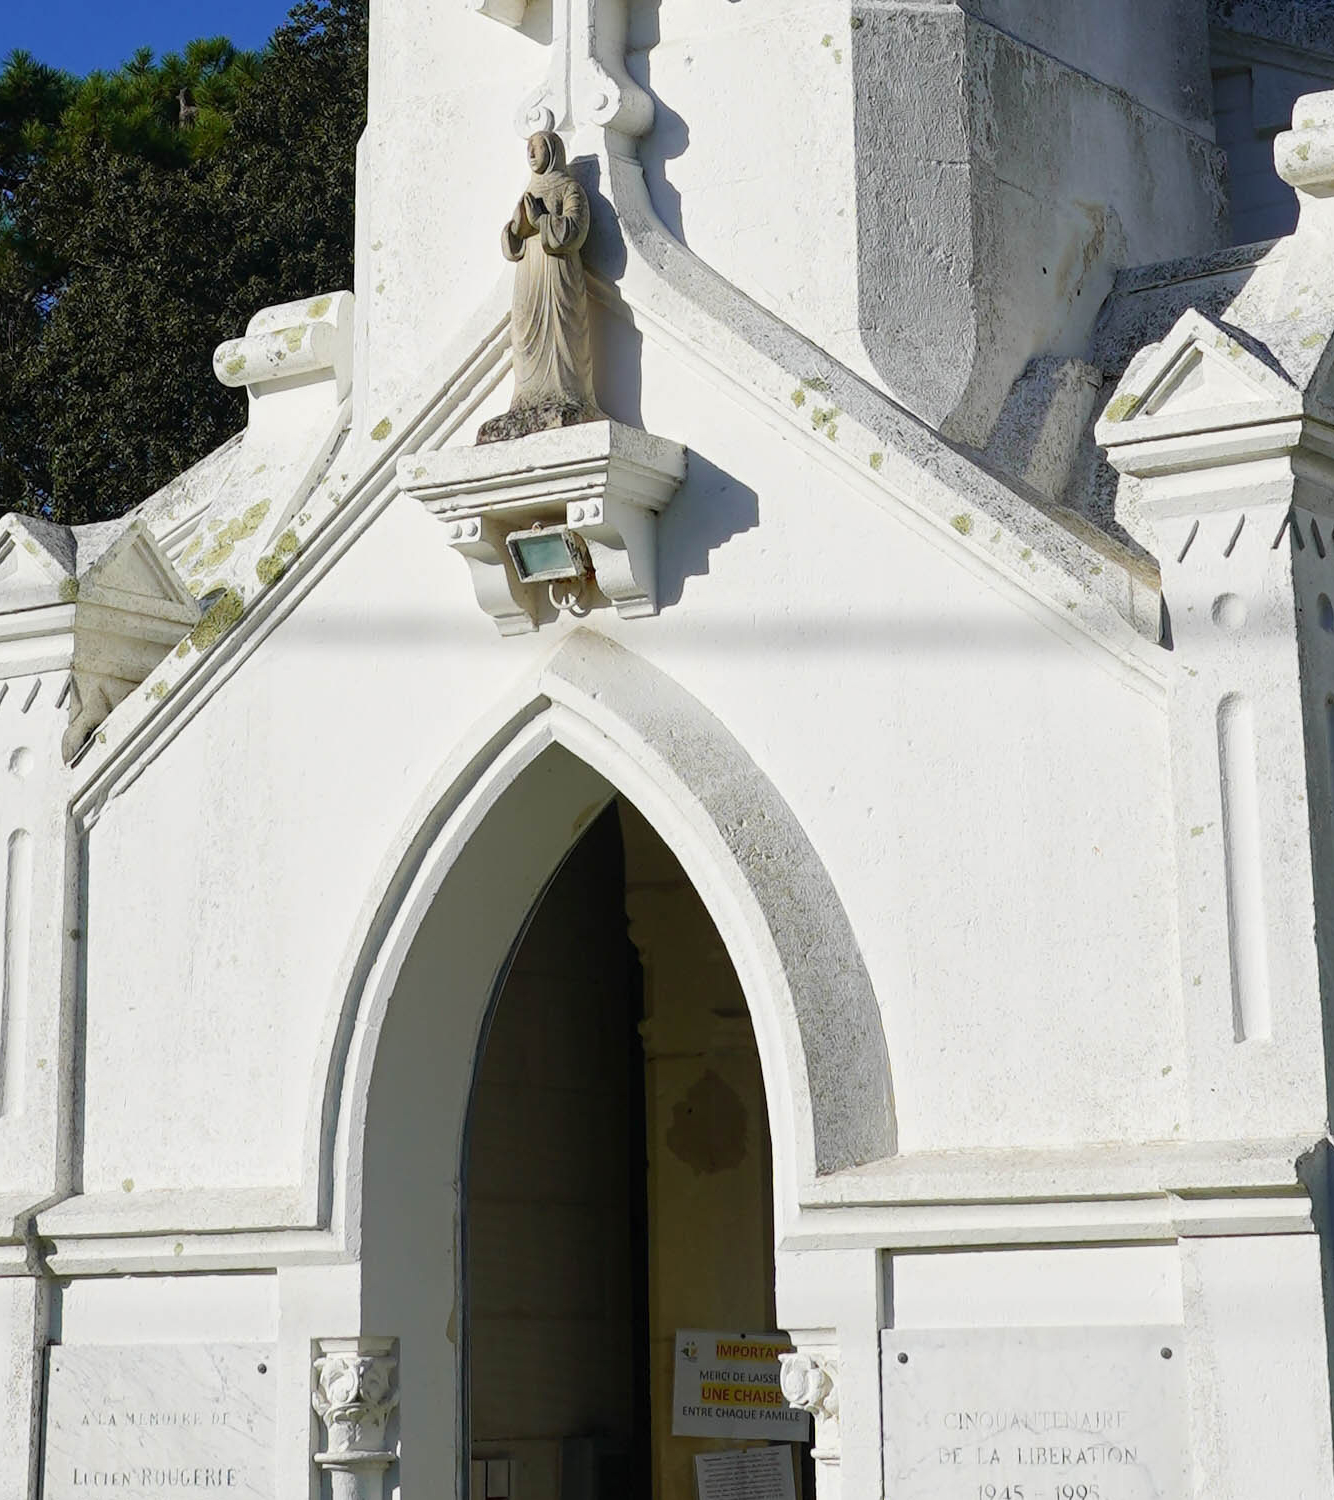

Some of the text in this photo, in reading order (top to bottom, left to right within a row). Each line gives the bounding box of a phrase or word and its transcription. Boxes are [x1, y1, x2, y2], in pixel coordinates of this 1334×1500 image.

[700, 1371, 729, 1381] MERCI
[733, 1373, 745, 1382] DE
[702, 1387, 782, 1403] UNE CHAISE
[99, 1413, 117, 1426] LA
[683, 1406, 800, 1421] ENTRE CHAQUE FAMILLE
[943, 1411, 1131, 1431] CINQUANTENAIRE
[939, 1447, 1138, 1465] DE LA LIBERATION
[141, 1468, 237, 1487] ROUGERIE
